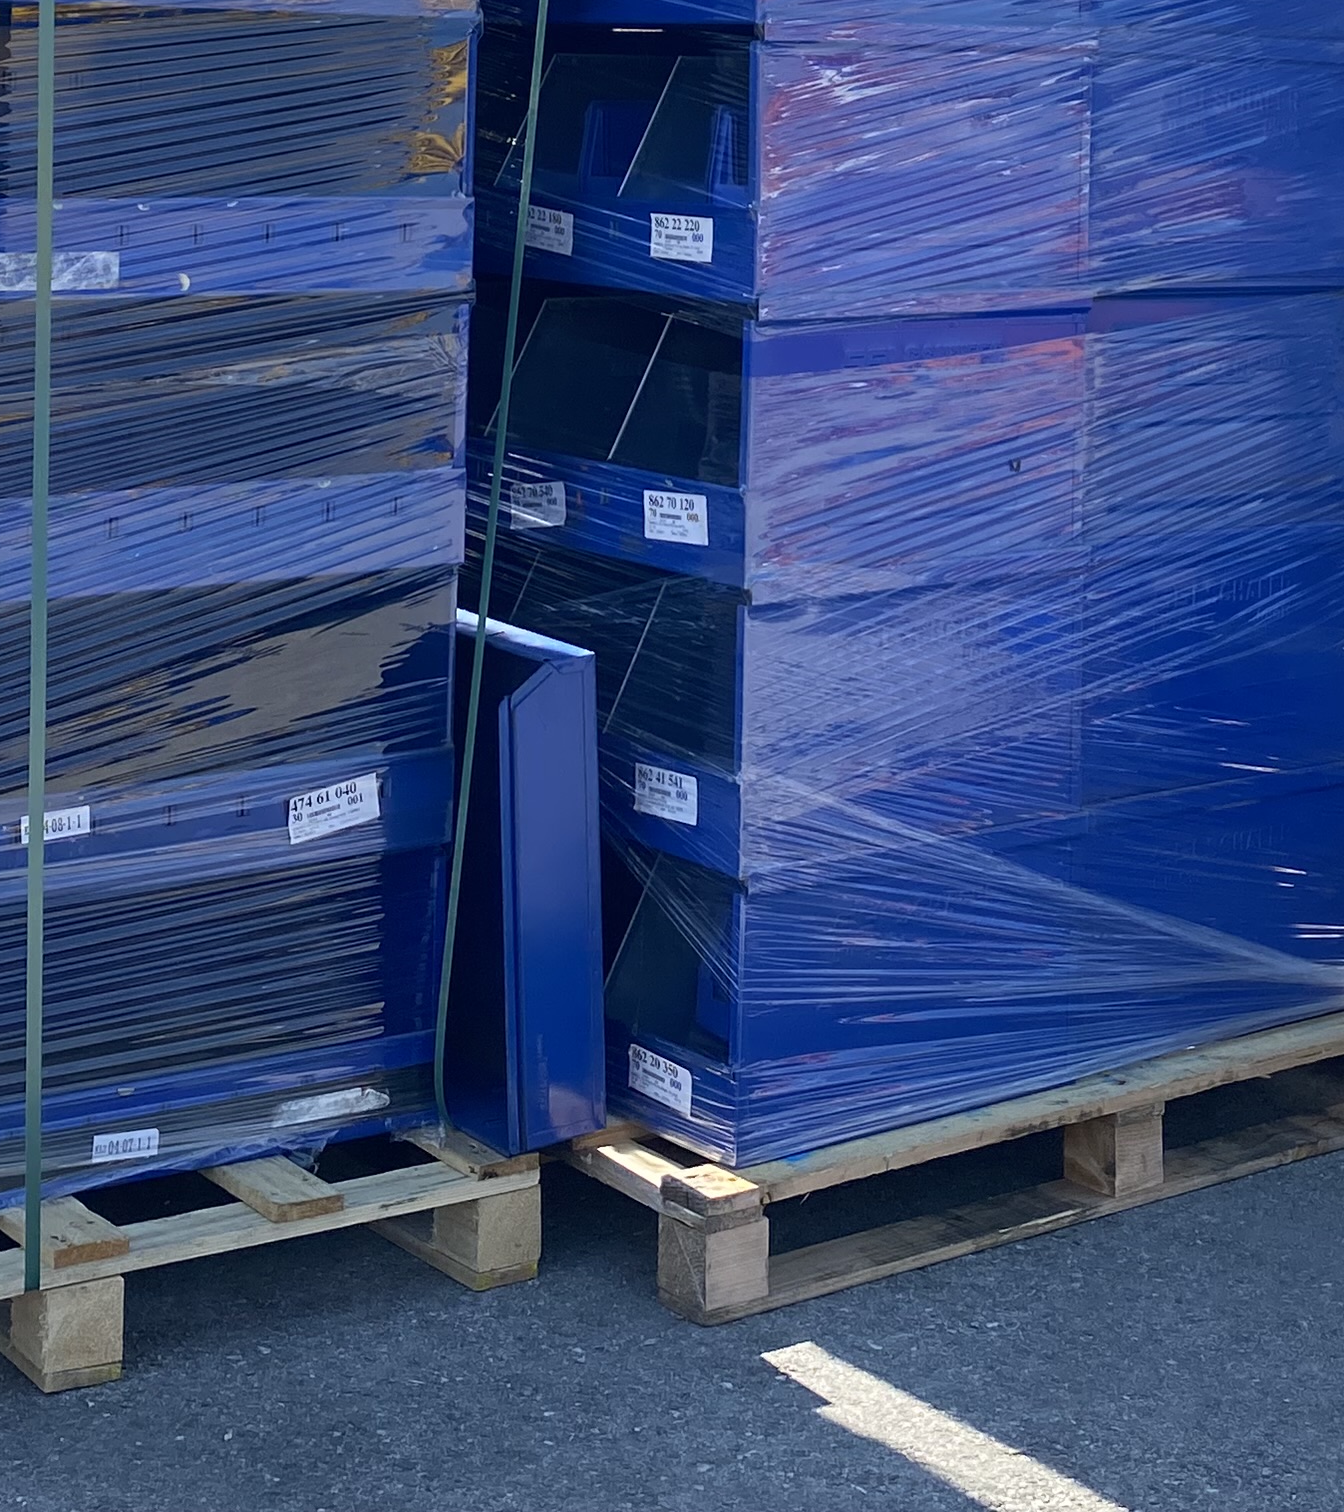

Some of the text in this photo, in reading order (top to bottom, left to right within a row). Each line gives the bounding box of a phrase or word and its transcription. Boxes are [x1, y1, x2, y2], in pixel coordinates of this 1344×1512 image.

[537, 209, 548, 222] 22
[671, 219, 682, 232] 22
[684, 220, 700, 233] 220
[692, 233, 704, 242] 000
[648, 494, 694, 511] 862 70 120
[655, 771, 665, 785] 41
[667, 773, 683, 789] 541
[291, 781, 357, 812] 474 61 040
[676, 789, 688, 801] 000
[292, 792, 364, 824] 30 001
[649, 1054, 661, 1070] 20
[662, 1060, 679, 1078] 350
[669, 1078, 682, 1092] 000
